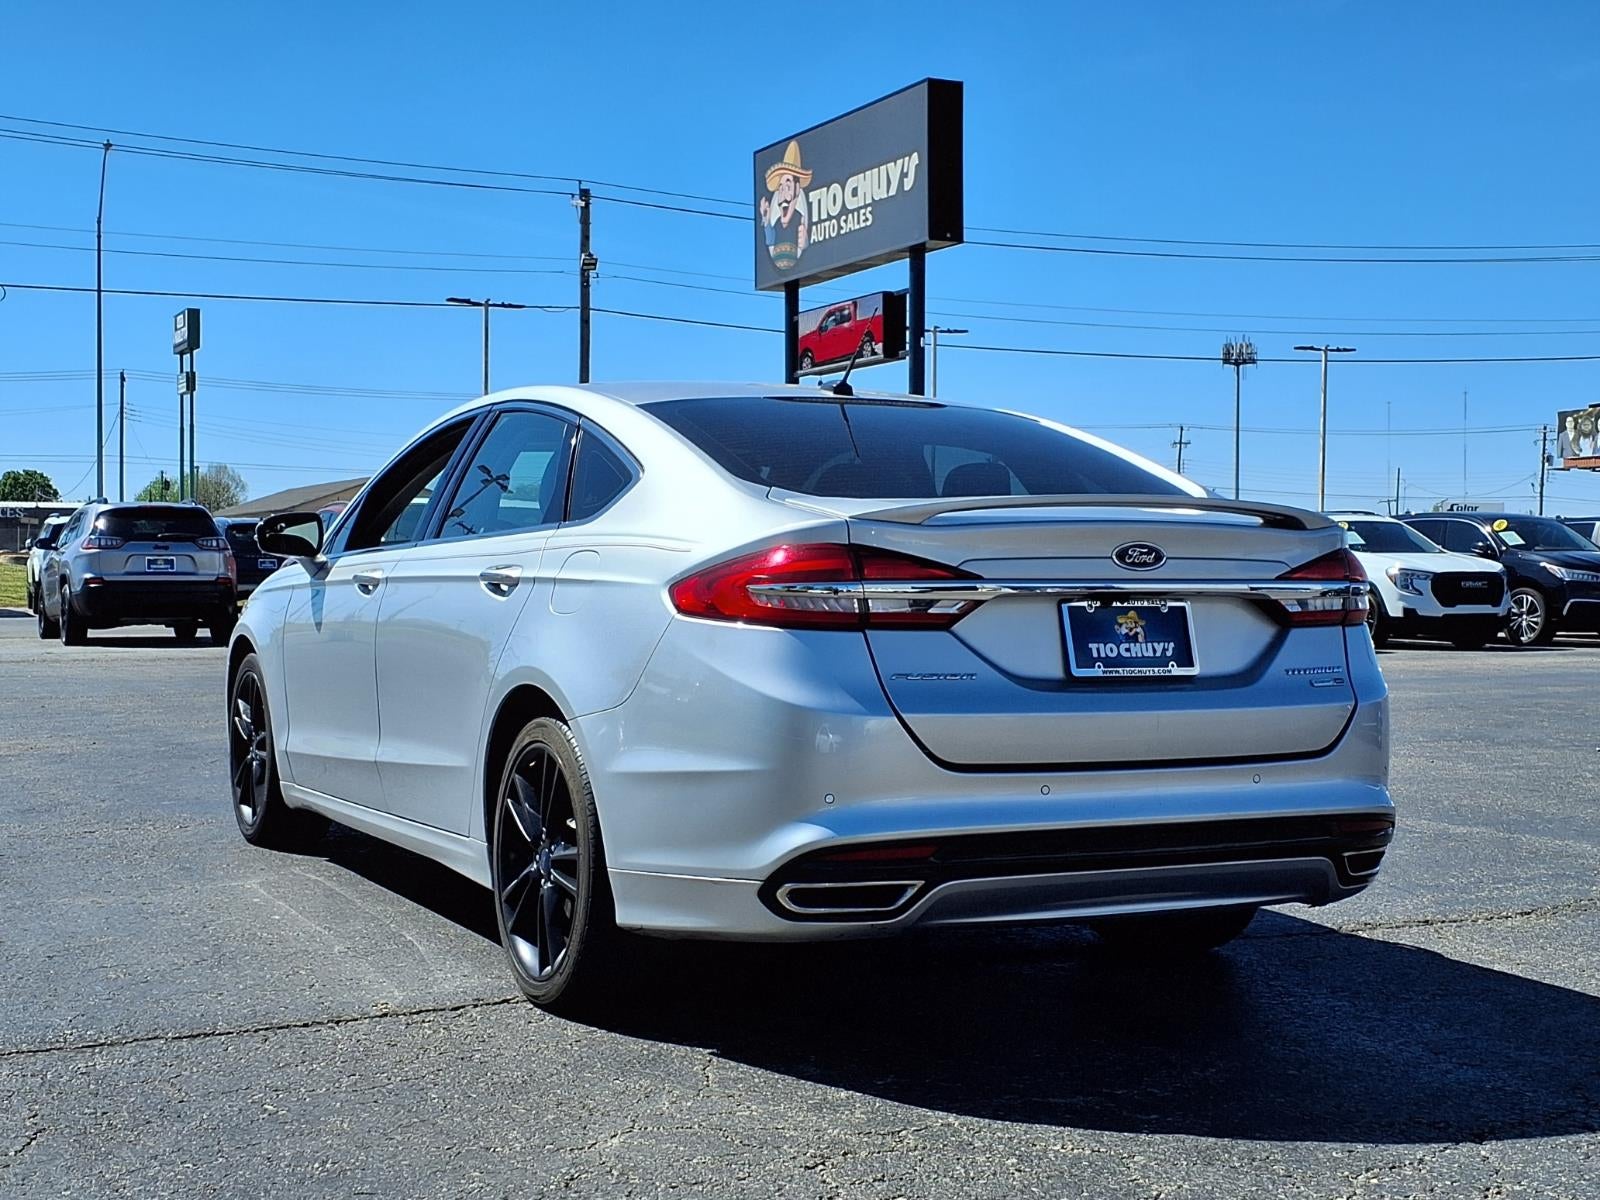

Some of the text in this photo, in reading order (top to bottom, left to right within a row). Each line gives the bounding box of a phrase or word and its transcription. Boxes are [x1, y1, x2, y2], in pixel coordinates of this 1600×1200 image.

[808, 152, 919, 223] TIO CHUY'S
[810, 206, 873, 244] AUTO SALES
[1125, 547, 1156, 563] Ford
[1088, 642, 1175, 658] TIO CHUY'S
[890, 672, 977, 681] FUSION
[1101, 668, 1173, 676] WWW.TIOCHUYS.COM
[1284, 665, 1343, 675] TITANIUM
